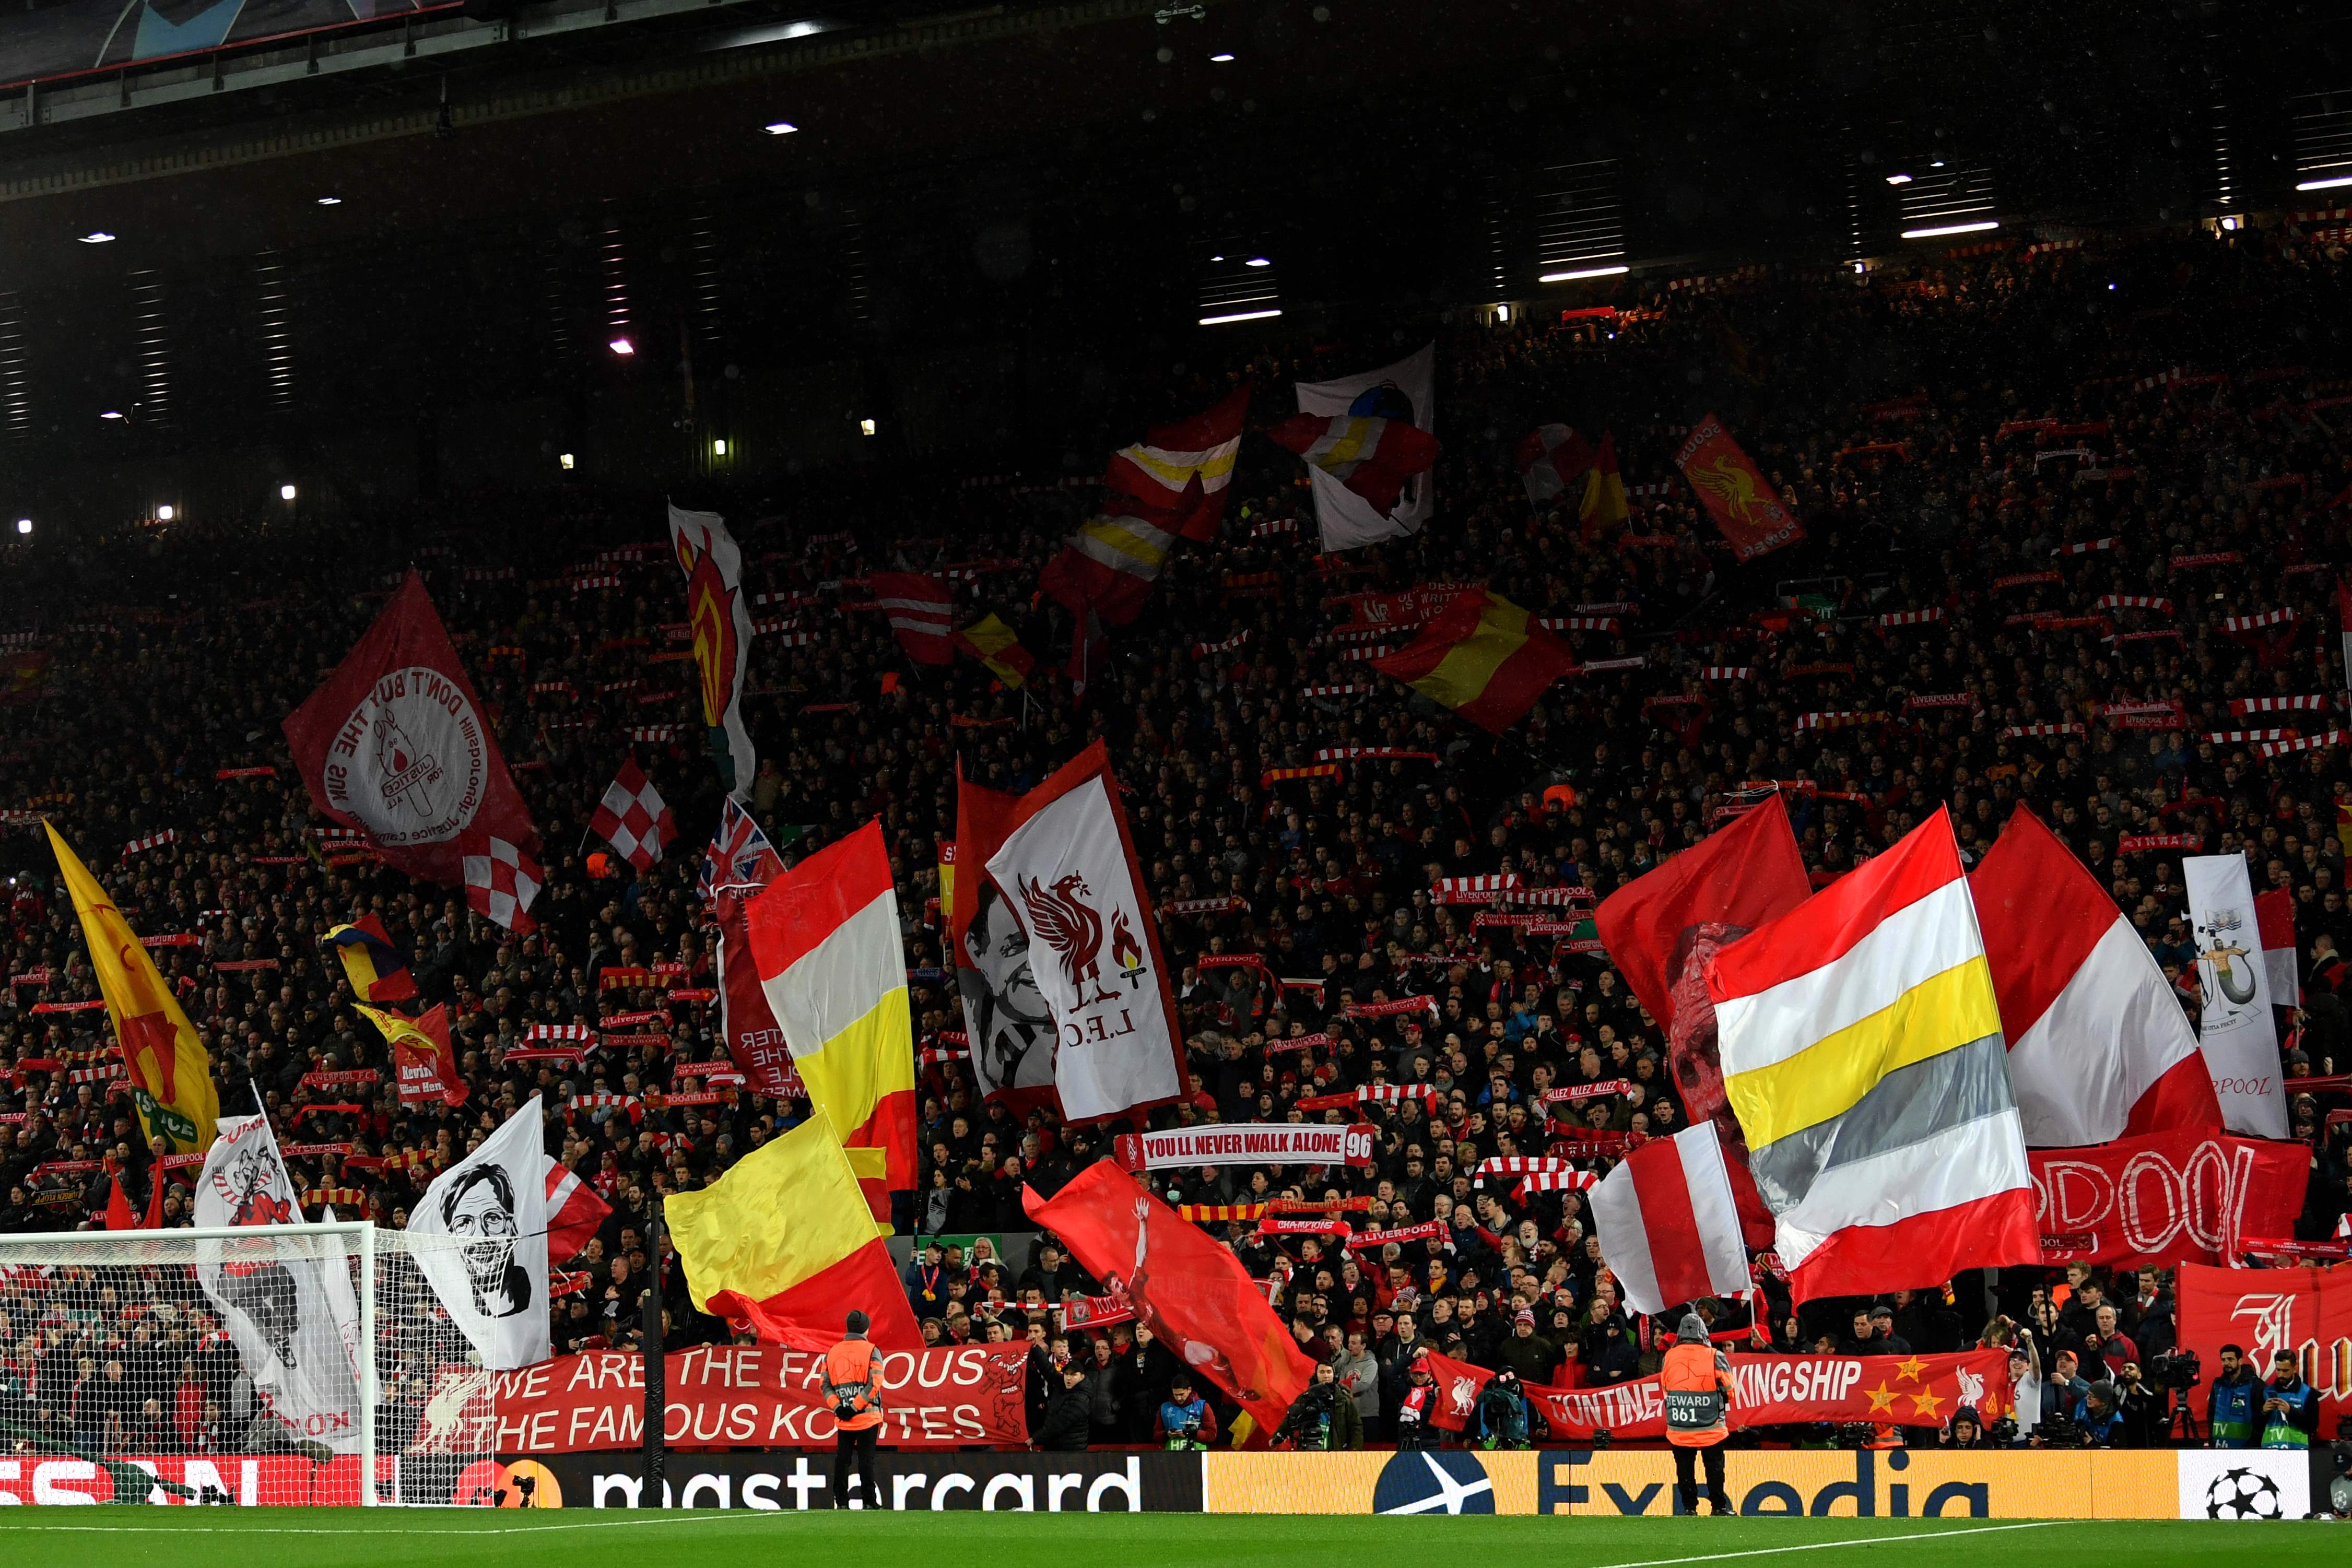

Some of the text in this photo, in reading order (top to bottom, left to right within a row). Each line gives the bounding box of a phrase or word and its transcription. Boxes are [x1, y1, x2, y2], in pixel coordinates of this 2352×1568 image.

[1912, 692, 1968, 704] LIVERPOOL FC
[1531, 922, 1571, 933] Liverpool
[1570, 940, 1604, 949] LIVERPOOL
[1199, 956, 1254, 965] LIVERPOOL
[1275, 1034, 1325, 1049] LIVERPOOL
[310, 1072, 356, 1082] LIVERPOOL
[1570, 1084, 1593, 1095] ALLEZ
[1594, 1080, 1617, 1093] ALLEZ
[284, 1144, 344, 1155] LIVERPOOL
[1195, 1134, 1242, 1155] NEVER
[1243, 1134, 1290, 1153] WALK
[1292, 1133, 1341, 1153] ALONE
[1346, 1132, 1371, 1158] 96
[165, 1152, 204, 1166] LIVERPOOL
[1277, 1220, 1336, 1230] CHAMPIONS
[1365, 1222, 1436, 1243] LIVERPOOL
[486, 1347, 987, 1400] WE ARE THE FAOUS
[1732, 1360, 1862, 1412] KINGSHIP
[1672, 1407, 1697, 1422] 861
[471, 1409, 560, 1451] THE
[769, 1404, 986, 1441] KOITES
[2213, 1423, 2228, 1435] TV
[2269, 1428, 2284, 1440] TV
